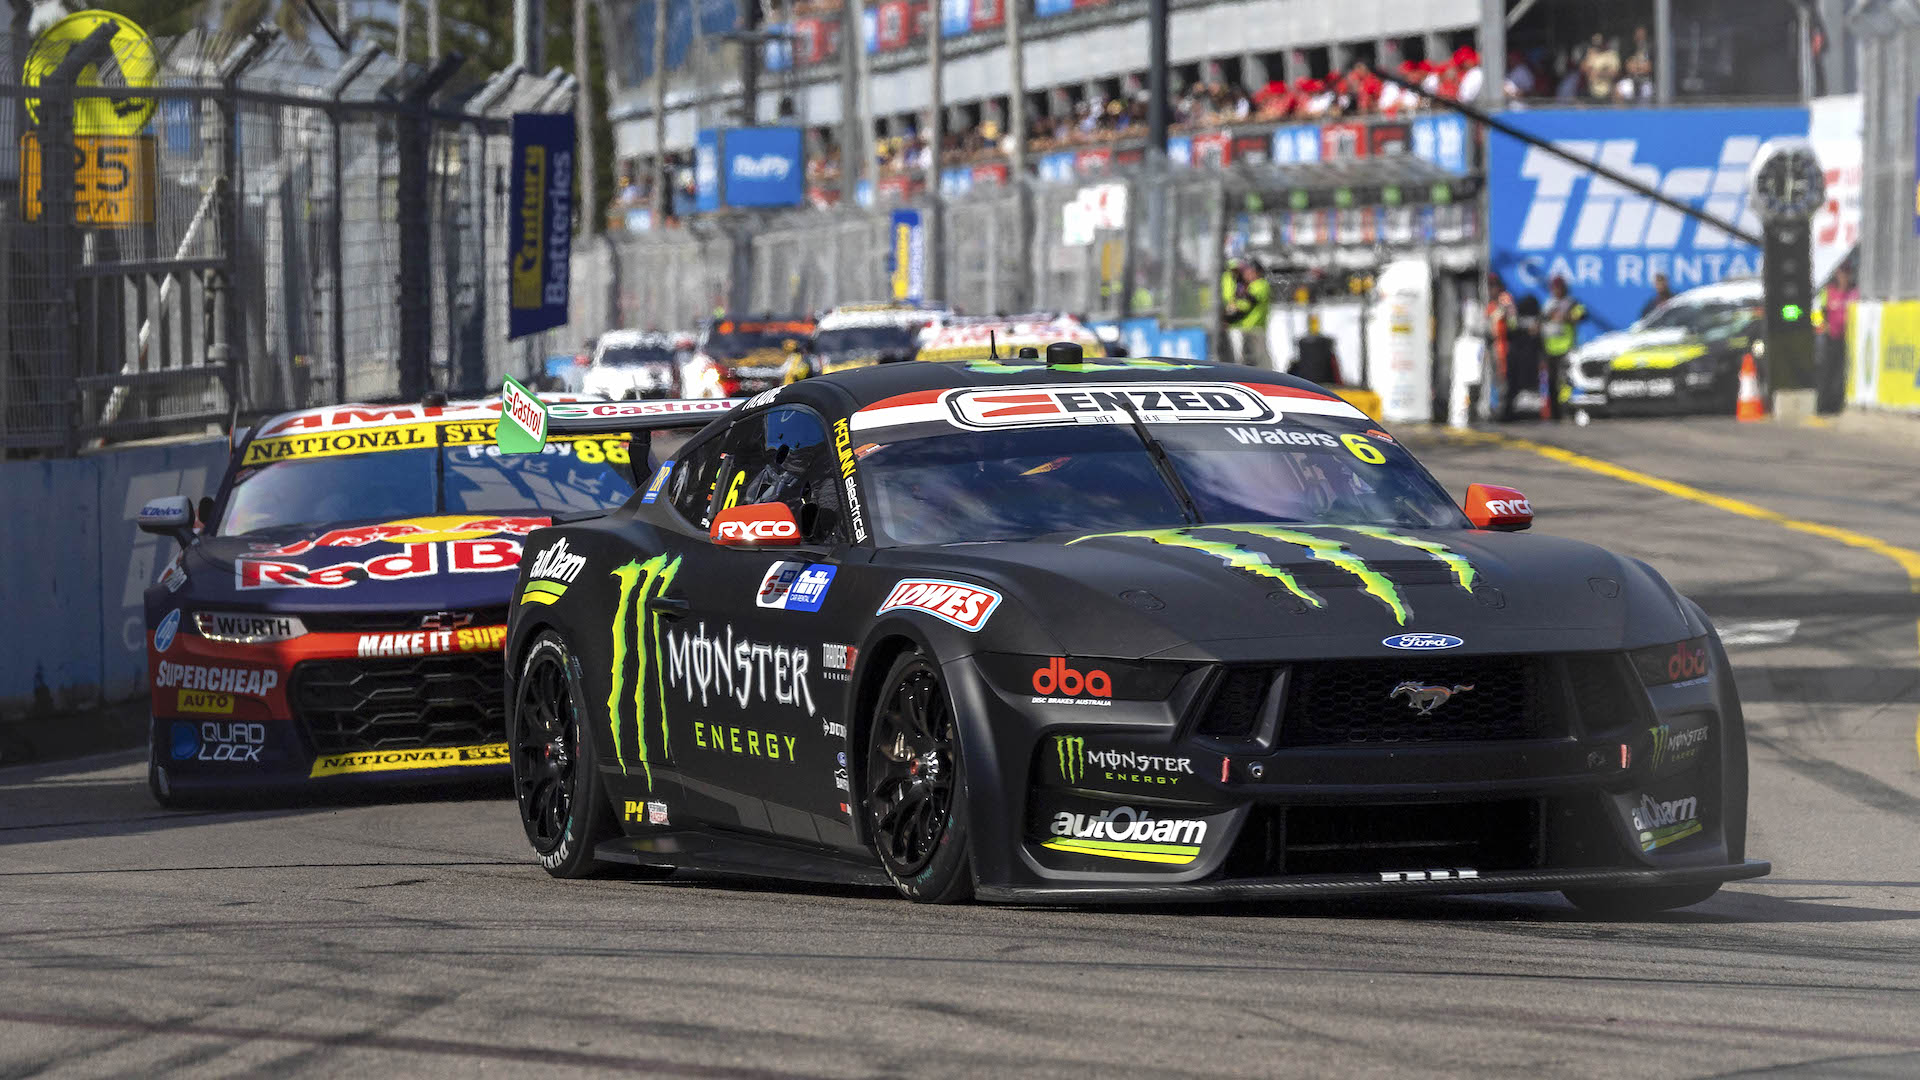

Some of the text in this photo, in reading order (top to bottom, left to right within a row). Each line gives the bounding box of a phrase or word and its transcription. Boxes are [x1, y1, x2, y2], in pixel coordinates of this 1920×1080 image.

[545, 151, 571, 304] Batteries
[1518, 254, 1602, 288] CAR
[512, 391, 542, 436] Castrol
[592, 401, 733, 417] Castrol
[1054, 390, 1246, 413] ENZED
[251, 428, 426, 461] NATIONAL
[574, 439, 631, 464] 88
[1224, 426, 1386, 465] Waters 6
[722, 470, 746, 511] 6
[844, 476, 868, 544] electrical
[718, 520, 796, 542] RYCO
[236, 541, 438, 591] Red
[883, 583, 989, 622] LOWES
[217, 616, 291, 636] WÜRTH
[358, 632, 425, 657] MAKE
[430, 631, 453, 650] IT
[1399, 635, 1448, 647] Ford
[156, 659, 278, 696] SUPERCHEAP
[1031, 656, 1112, 698] dba
[183, 694, 229, 708] AUTO
[1075, 699, 1111, 707] AUSTRALIA
[201, 722, 265, 744] QUAD
[694, 721, 796, 762] ENERGY
[199, 744, 265, 762] LOCK
[322, 751, 454, 769] NATIONAL
[1105, 772, 1180, 785] ENERGY
